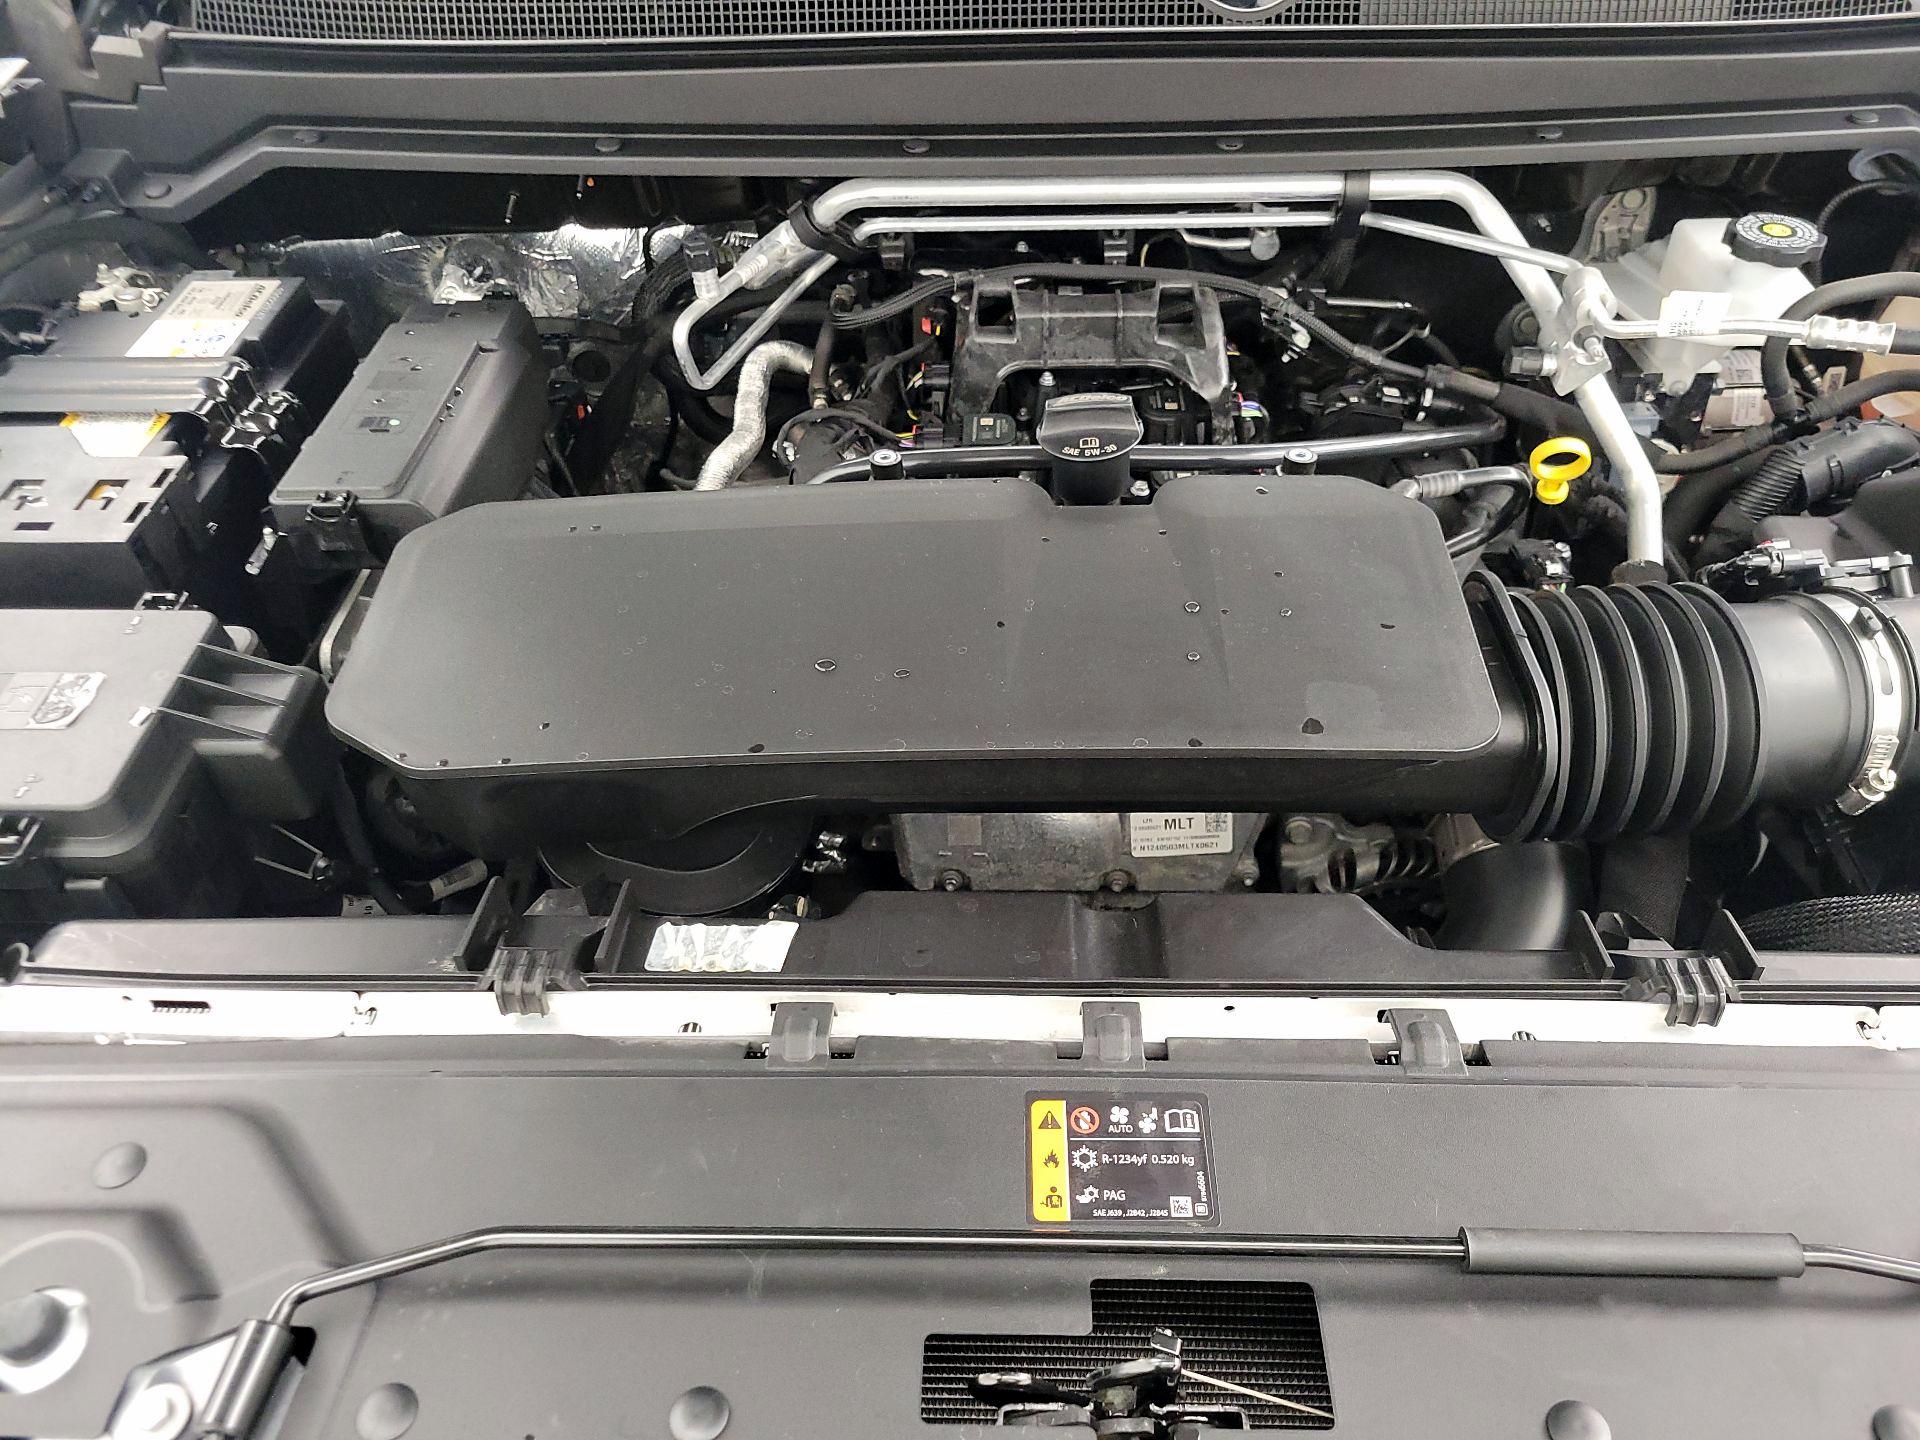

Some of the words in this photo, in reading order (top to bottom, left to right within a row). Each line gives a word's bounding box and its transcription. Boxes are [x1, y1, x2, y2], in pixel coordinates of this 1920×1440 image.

[1062, 446, 1081, 456] SAE
[1084, 444, 1118, 456] 5W-30
[1164, 818, 1195, 830] MLT
[1108, 1124, 1134, 1133] AUTO
[1101, 1154, 1148, 1167] R-1234yf
[1151, 1154, 1179, 1165] 0.520
[1182, 1154, 1195, 1166] kg
[1103, 1189, 1126, 1201] PAG
[1093, 1209, 1107, 1217] SAE
